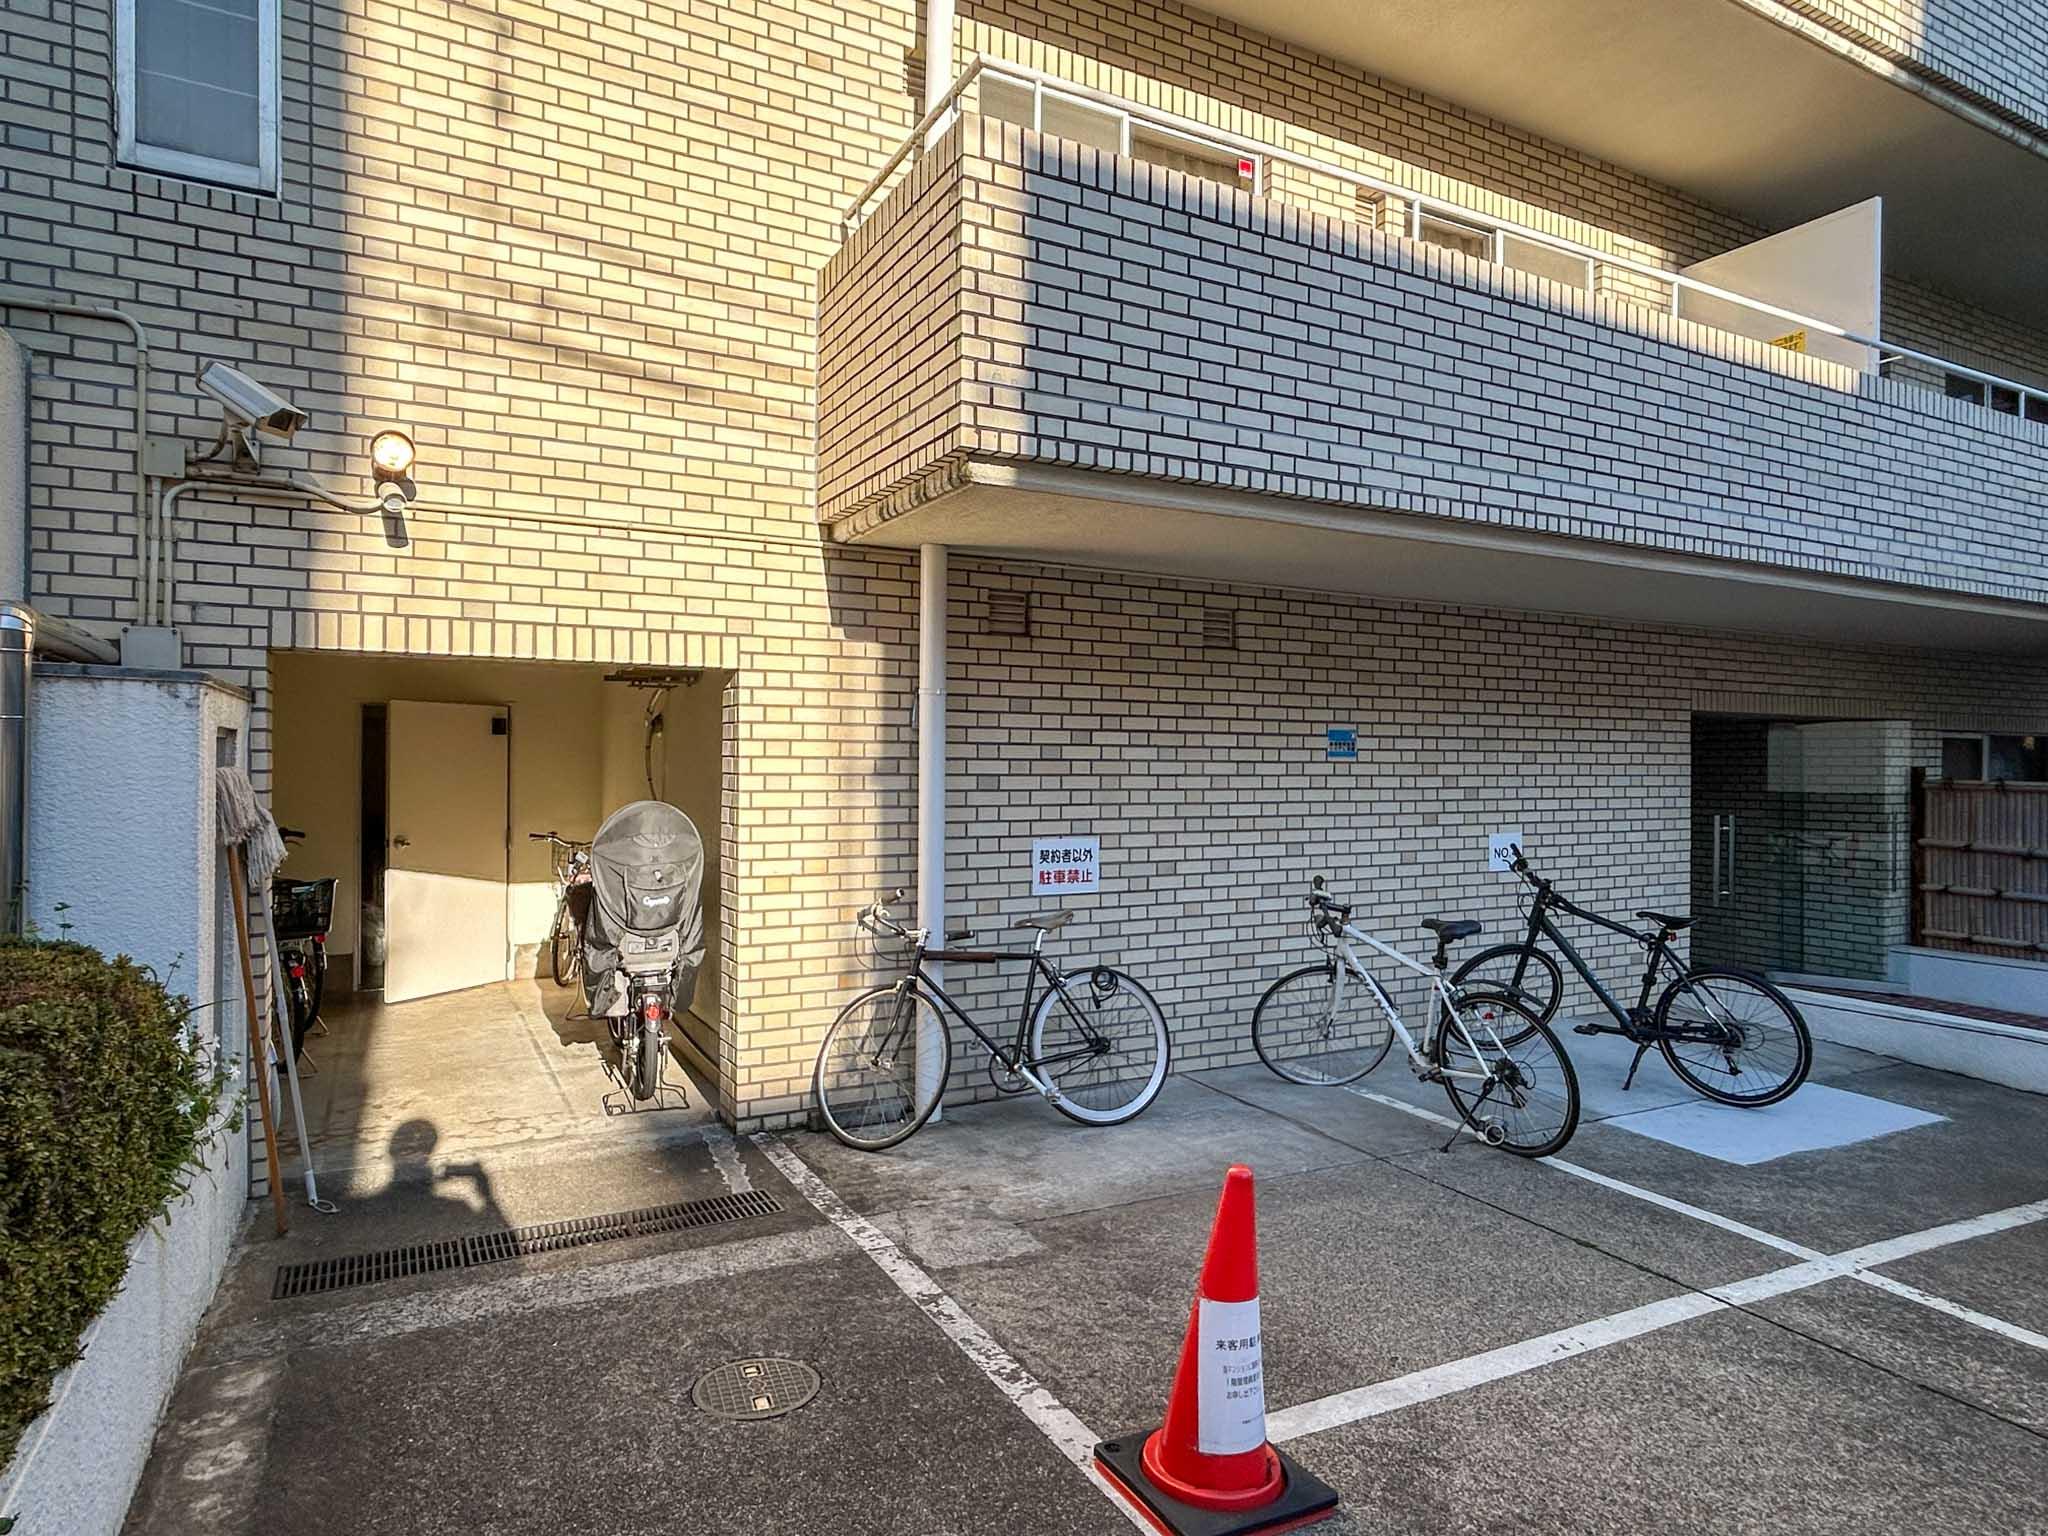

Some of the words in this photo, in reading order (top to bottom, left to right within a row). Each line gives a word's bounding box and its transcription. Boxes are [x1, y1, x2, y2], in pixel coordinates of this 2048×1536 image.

[1039, 848, 1093, 864] 契約者以外
[1039, 868, 1093, 885] 駐車禁止
